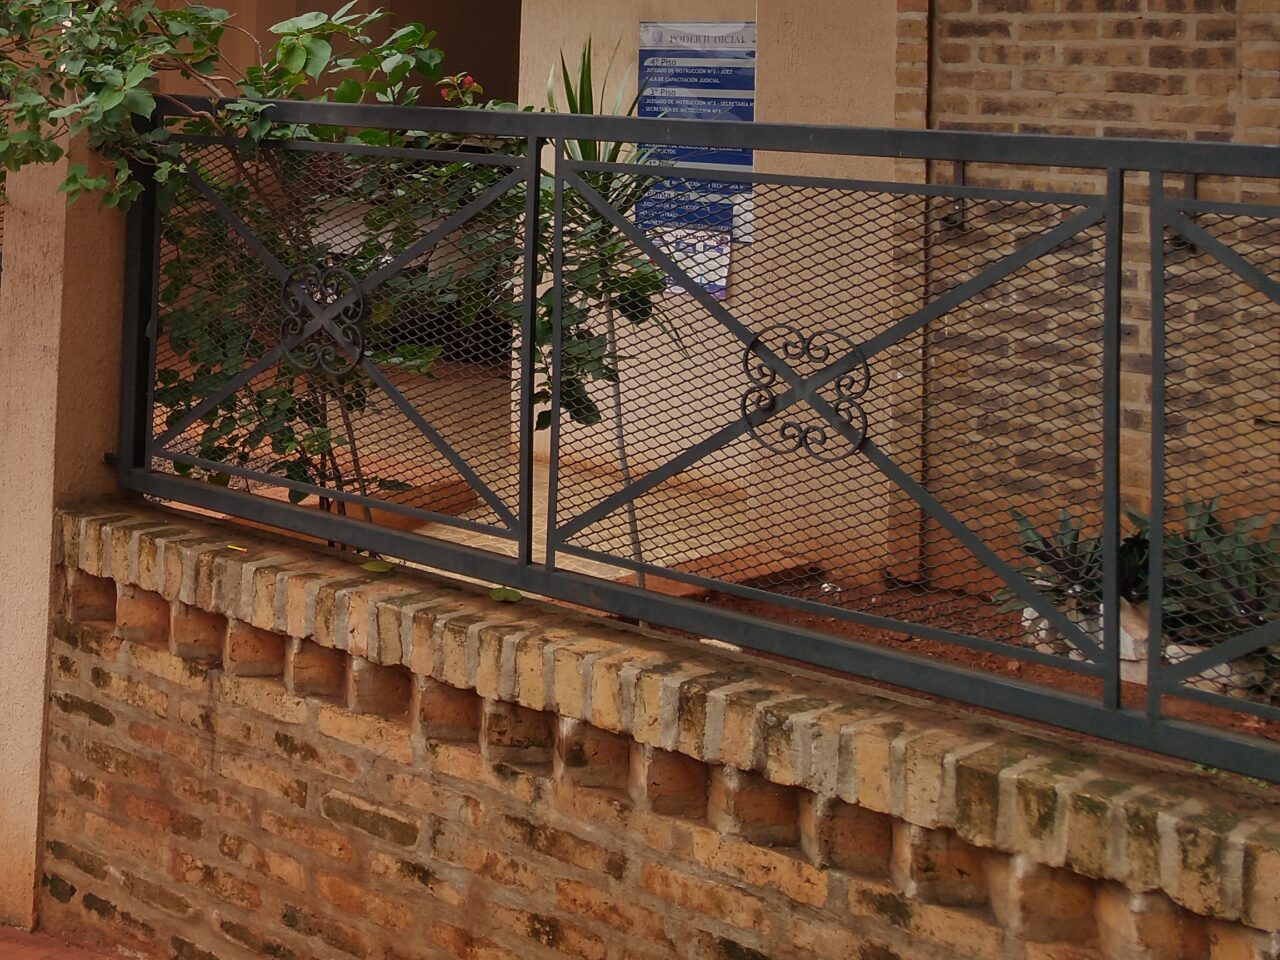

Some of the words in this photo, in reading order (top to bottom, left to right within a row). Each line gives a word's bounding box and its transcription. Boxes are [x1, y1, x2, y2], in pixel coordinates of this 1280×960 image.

[670, 35, 700, 44] PODER
[661, 58, 677, 66] Piso
[661, 88, 676, 96] Piso
